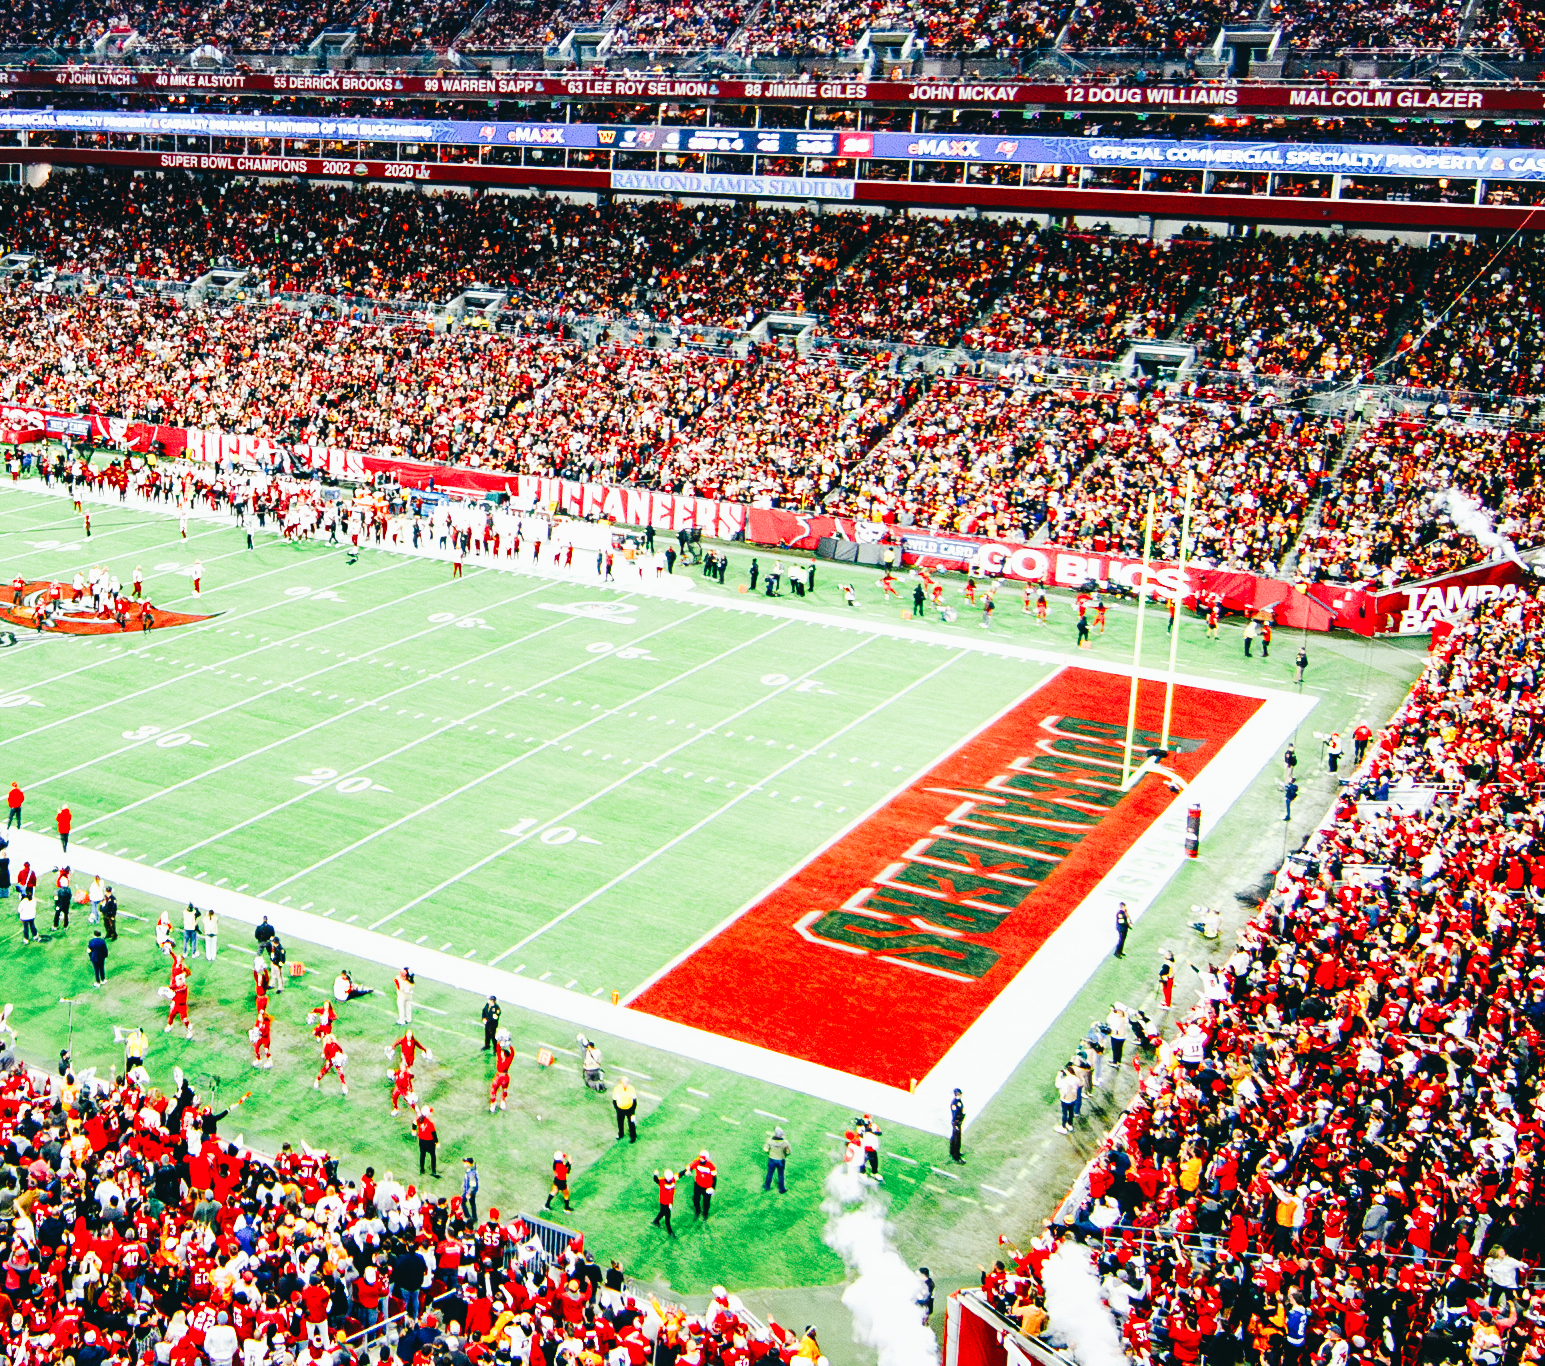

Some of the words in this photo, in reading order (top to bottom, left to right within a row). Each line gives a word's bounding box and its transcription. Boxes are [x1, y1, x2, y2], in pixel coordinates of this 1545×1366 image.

[56, 73, 66, 83] 47
[69, 73, 95, 85] JOHN
[98, 74, 130, 85] LYNCH
[156, 75, 167, 85] 40
[170, 75, 195, 86] MIKE
[198, 76, 245, 87] ALSTOTT
[274, 77, 286, 88] 55
[290, 77, 339, 89] DERRICK
[343, 78, 392, 90] BROOKS
[425, 79, 438, 91] 99
[442, 80, 495, 91] WARREN
[499, 80, 533, 92] SAPP
[568, 81, 582, 93] 63
[586, 81, 612, 94] LEE
[616, 82, 643, 95] ROY
[648, 82, 708, 96] SELMON
[745, 84, 761, 96] 88
[765, 84, 817, 97] JIMMIE
[821, 85, 866, 98] GILES
[909, 86, 954, 99] JOHN
[959, 86, 1018, 100] MCKAY
[1065, 88, 1084, 101] 12
[1089, 88, 1141, 102] DOUG
[1147, 89, 1237, 104] WILLIAMS
[1290, 91, 1391, 106] MALCOLM
[1398, 92, 1482, 107] GLAZER
[321, 123, 334, 134] OF
[336, 124, 357, 135] THE
[359, 124, 432, 137] BUCCANEERS
[908, 139, 979, 157] eMAXX
[161, 155, 197, 167] SUPER
[201, 157, 234, 169] BOWL
[237, 158, 307, 172] CHAMPIONS
[323, 161, 350, 174] 2002
[1089, 145, 1163, 162] OFFICIAL
[1168, 147, 1282, 165] COMMERCIAL
[1286, 150, 1383, 167] SPECIALTY
[1386, 154, 1488, 171] PROPERTY
[1491, 157, 1504, 171] &
[385, 164, 413, 177] 2020
[613, 173, 701, 191] RAYMOND
[704, 177, 763, 193] JAMES
[769, 181, 851, 197] STADIUM
[977, 543, 1049, 579] GO
[1055, 554, 1191, 599] BUCS
[1402, 584, 1517, 611] TAMPA
[295, 767, 374, 793] 20
[500, 817, 579, 846] 10
[793, 715, 1206, 983] BUCCANEERS
[484, 1228, 500, 1246] 55
[123, 1252, 138, 1266] 40
